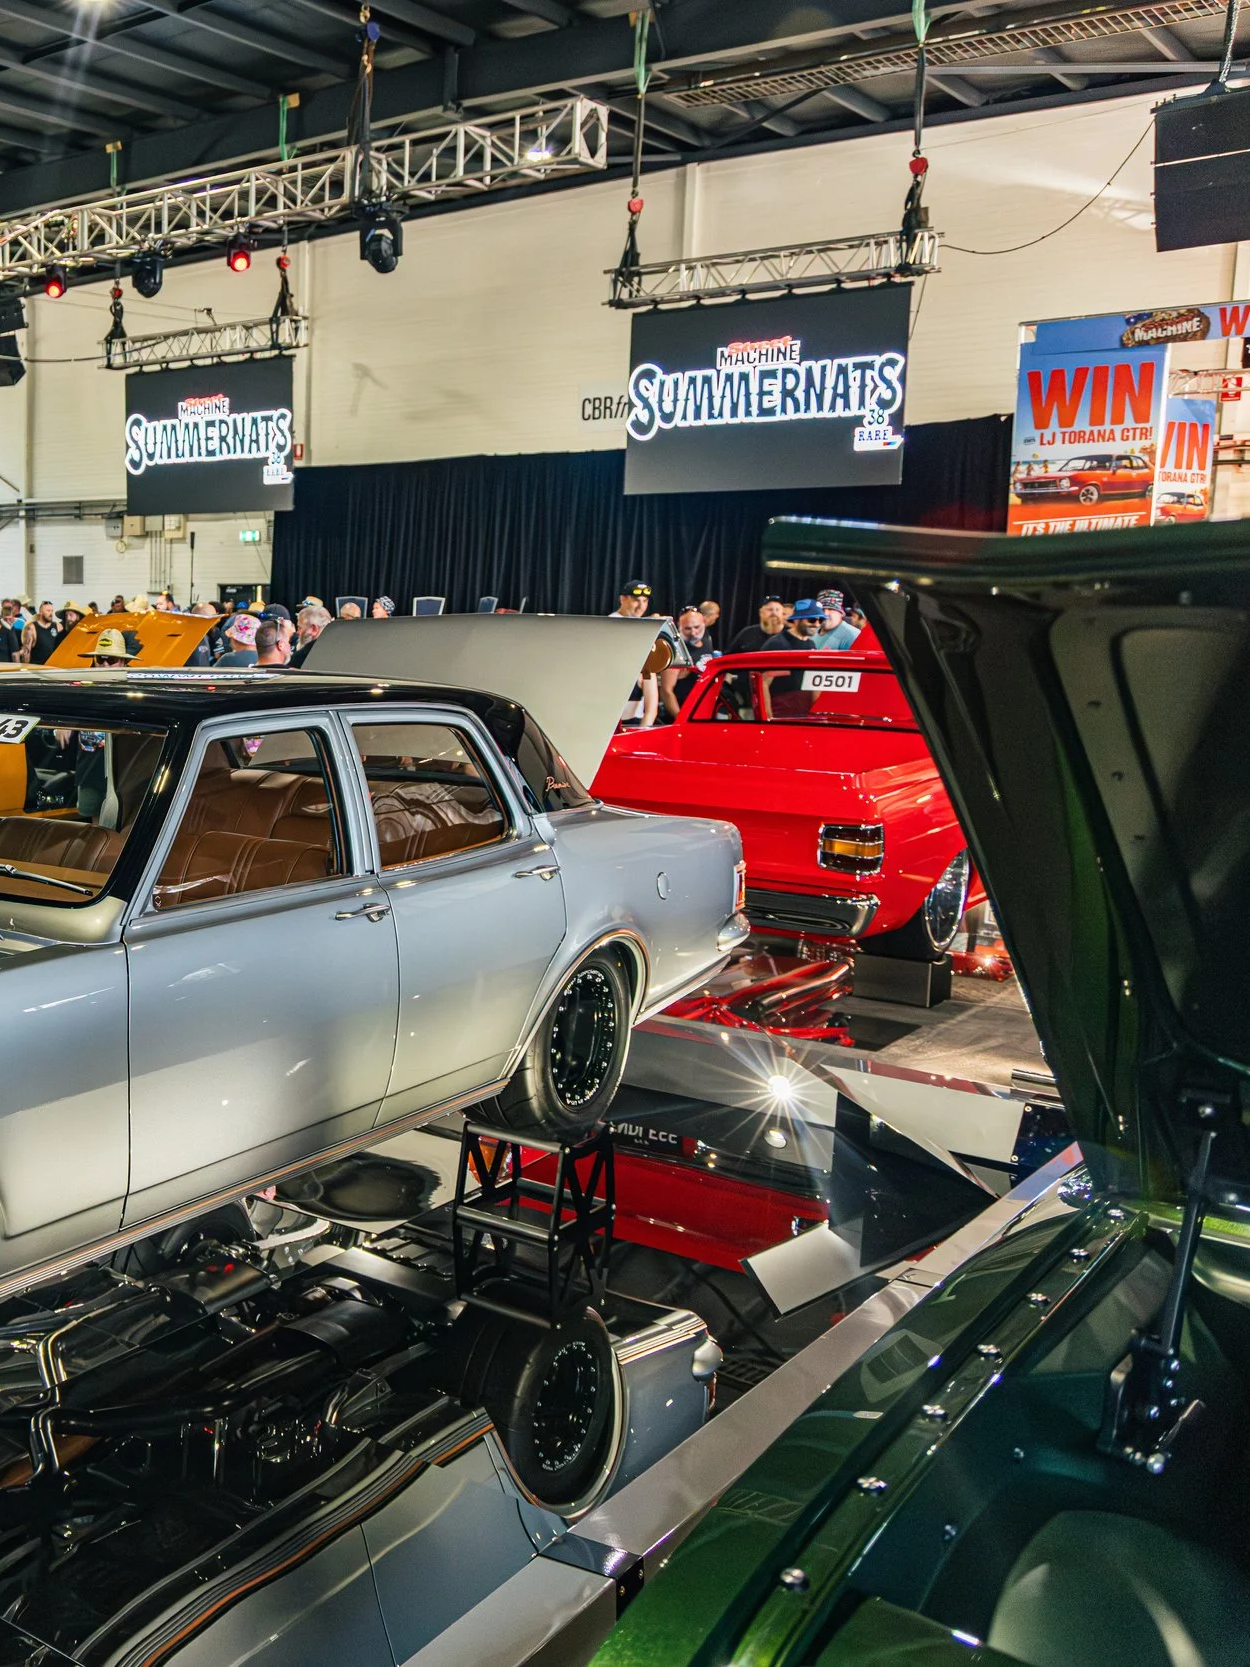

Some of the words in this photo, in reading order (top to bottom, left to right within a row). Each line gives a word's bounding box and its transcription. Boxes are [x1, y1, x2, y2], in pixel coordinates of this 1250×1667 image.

[1219, 304, 1250, 337] W
[719, 342, 798, 367] MACHINE
[630, 356, 901, 437] SUMMERNATS
[1027, 362, 1155, 430] WIN
[179, 399, 229, 416] MACHINE
[582, 395, 629, 421] CBRfr
[867, 409, 885, 425] 38
[126, 411, 291, 474] SUMMERNATS
[858, 429, 889, 442] RARE
[1040, 432, 1056, 446] LJ
[1060, 428, 1116, 445] TORANA
[1120, 426, 1153, 442] GTR!
[1048, 519, 1073, 535] THE
[1074, 515, 1141, 533] ULTIMATE
[812, 675, 853, 688] 0501
